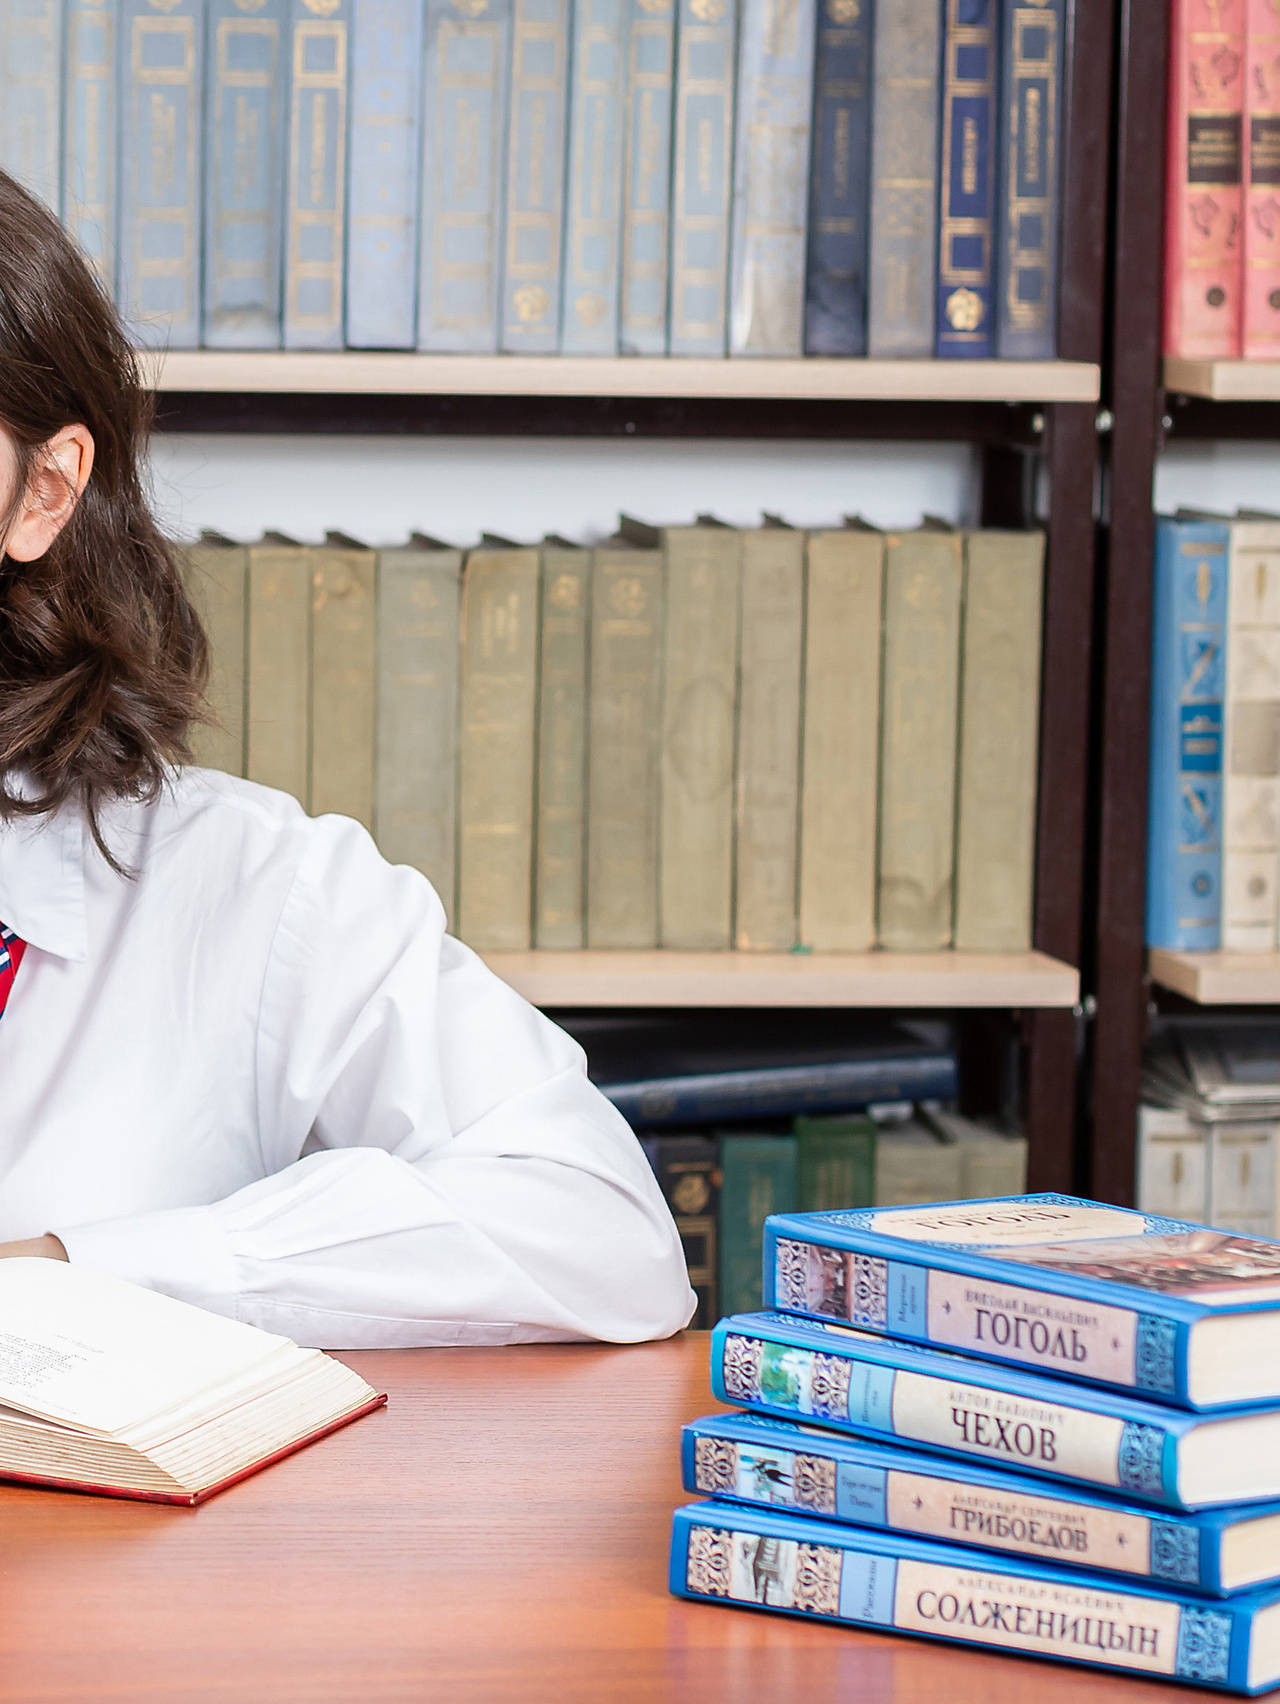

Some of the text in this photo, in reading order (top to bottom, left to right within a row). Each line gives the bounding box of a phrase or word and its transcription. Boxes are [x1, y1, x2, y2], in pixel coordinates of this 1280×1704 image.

[916, 1211, 1072, 1230] ГОГОЛЬ
[975, 1308, 1088, 1363] ГОГОЛЬ
[951, 1407, 1058, 1463] ЧЕХОВ
[950, 1506, 1089, 1553] ГРИБОЕДОВ
[957, 1576, 1047, 1600] АЛЕКСАНДР
[916, 1590, 1160, 1658] СОЛЖЕНИЦЫН
